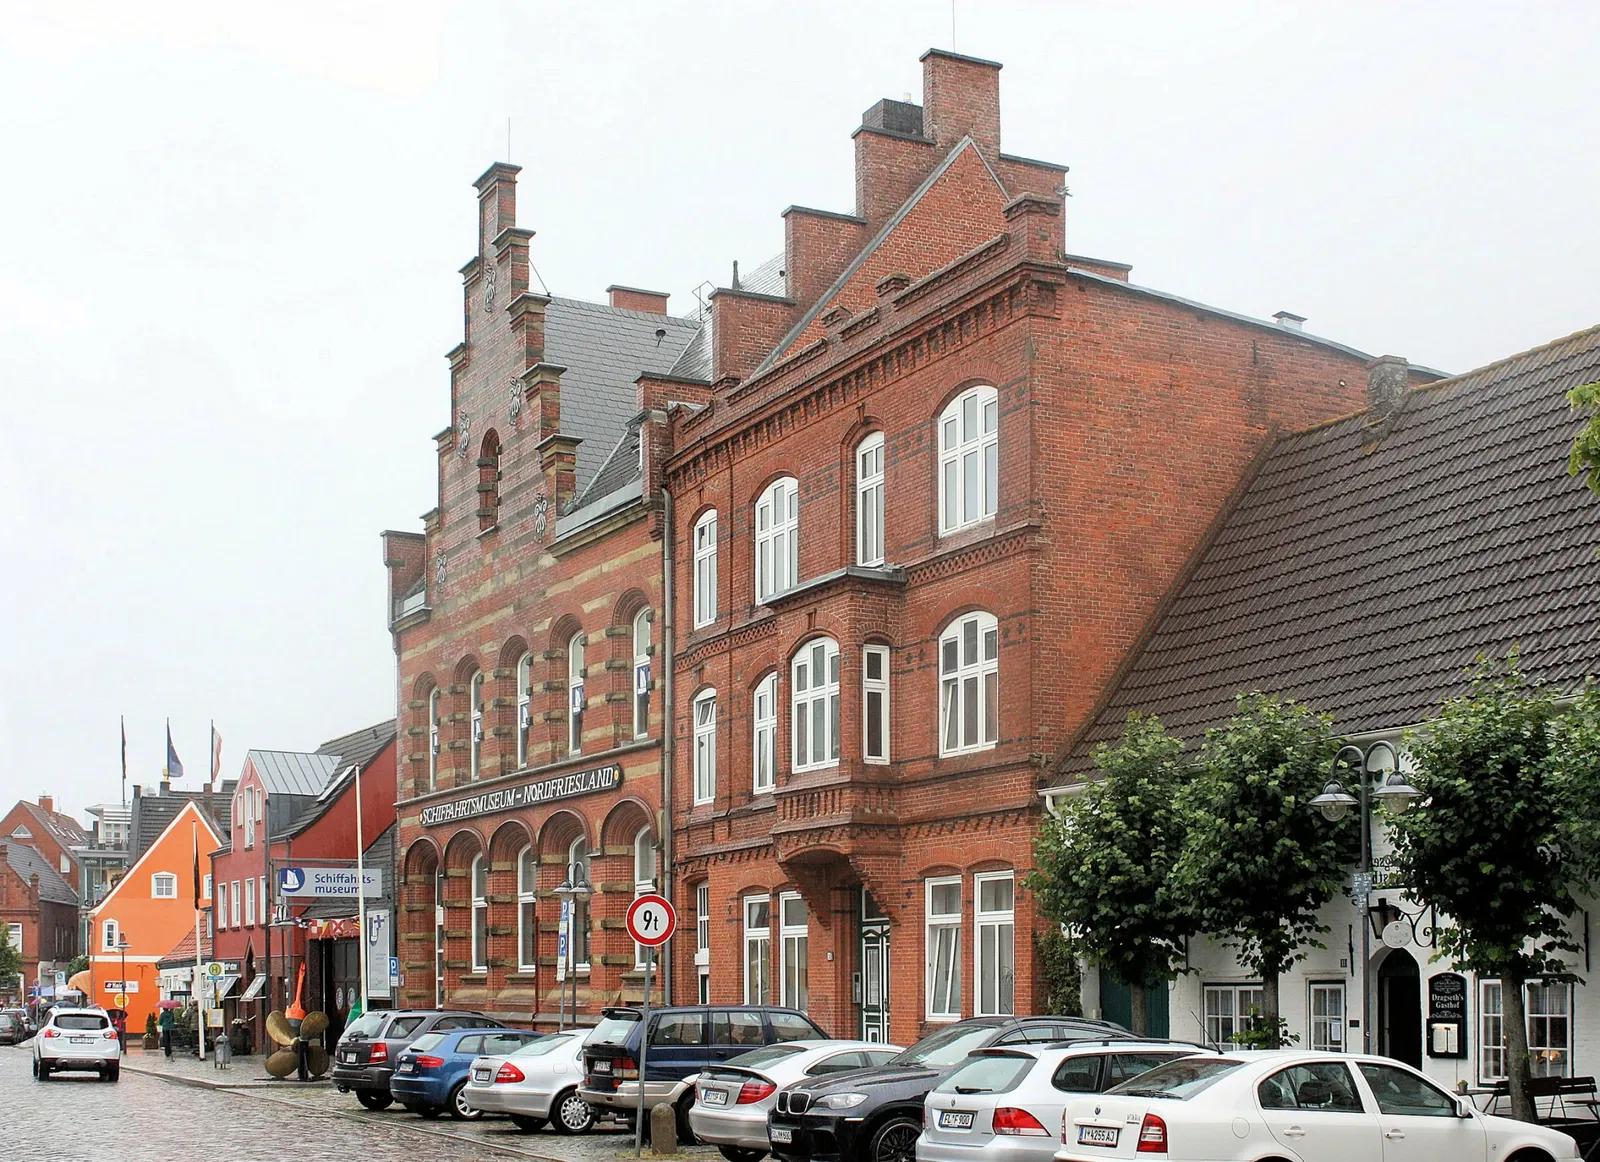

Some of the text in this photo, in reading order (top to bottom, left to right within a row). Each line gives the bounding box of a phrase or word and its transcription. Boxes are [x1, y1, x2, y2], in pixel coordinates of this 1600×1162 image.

[422, 789, 516, 825] SCHIFFAHRTSMUSEUM
[522, 767, 614, 804] NORDFRIESLAND
[315, 886, 360, 894] museum
[1431, 993, 1464, 1002] Dragseth's
[1435, 1001, 1460, 1009] Gasthof
